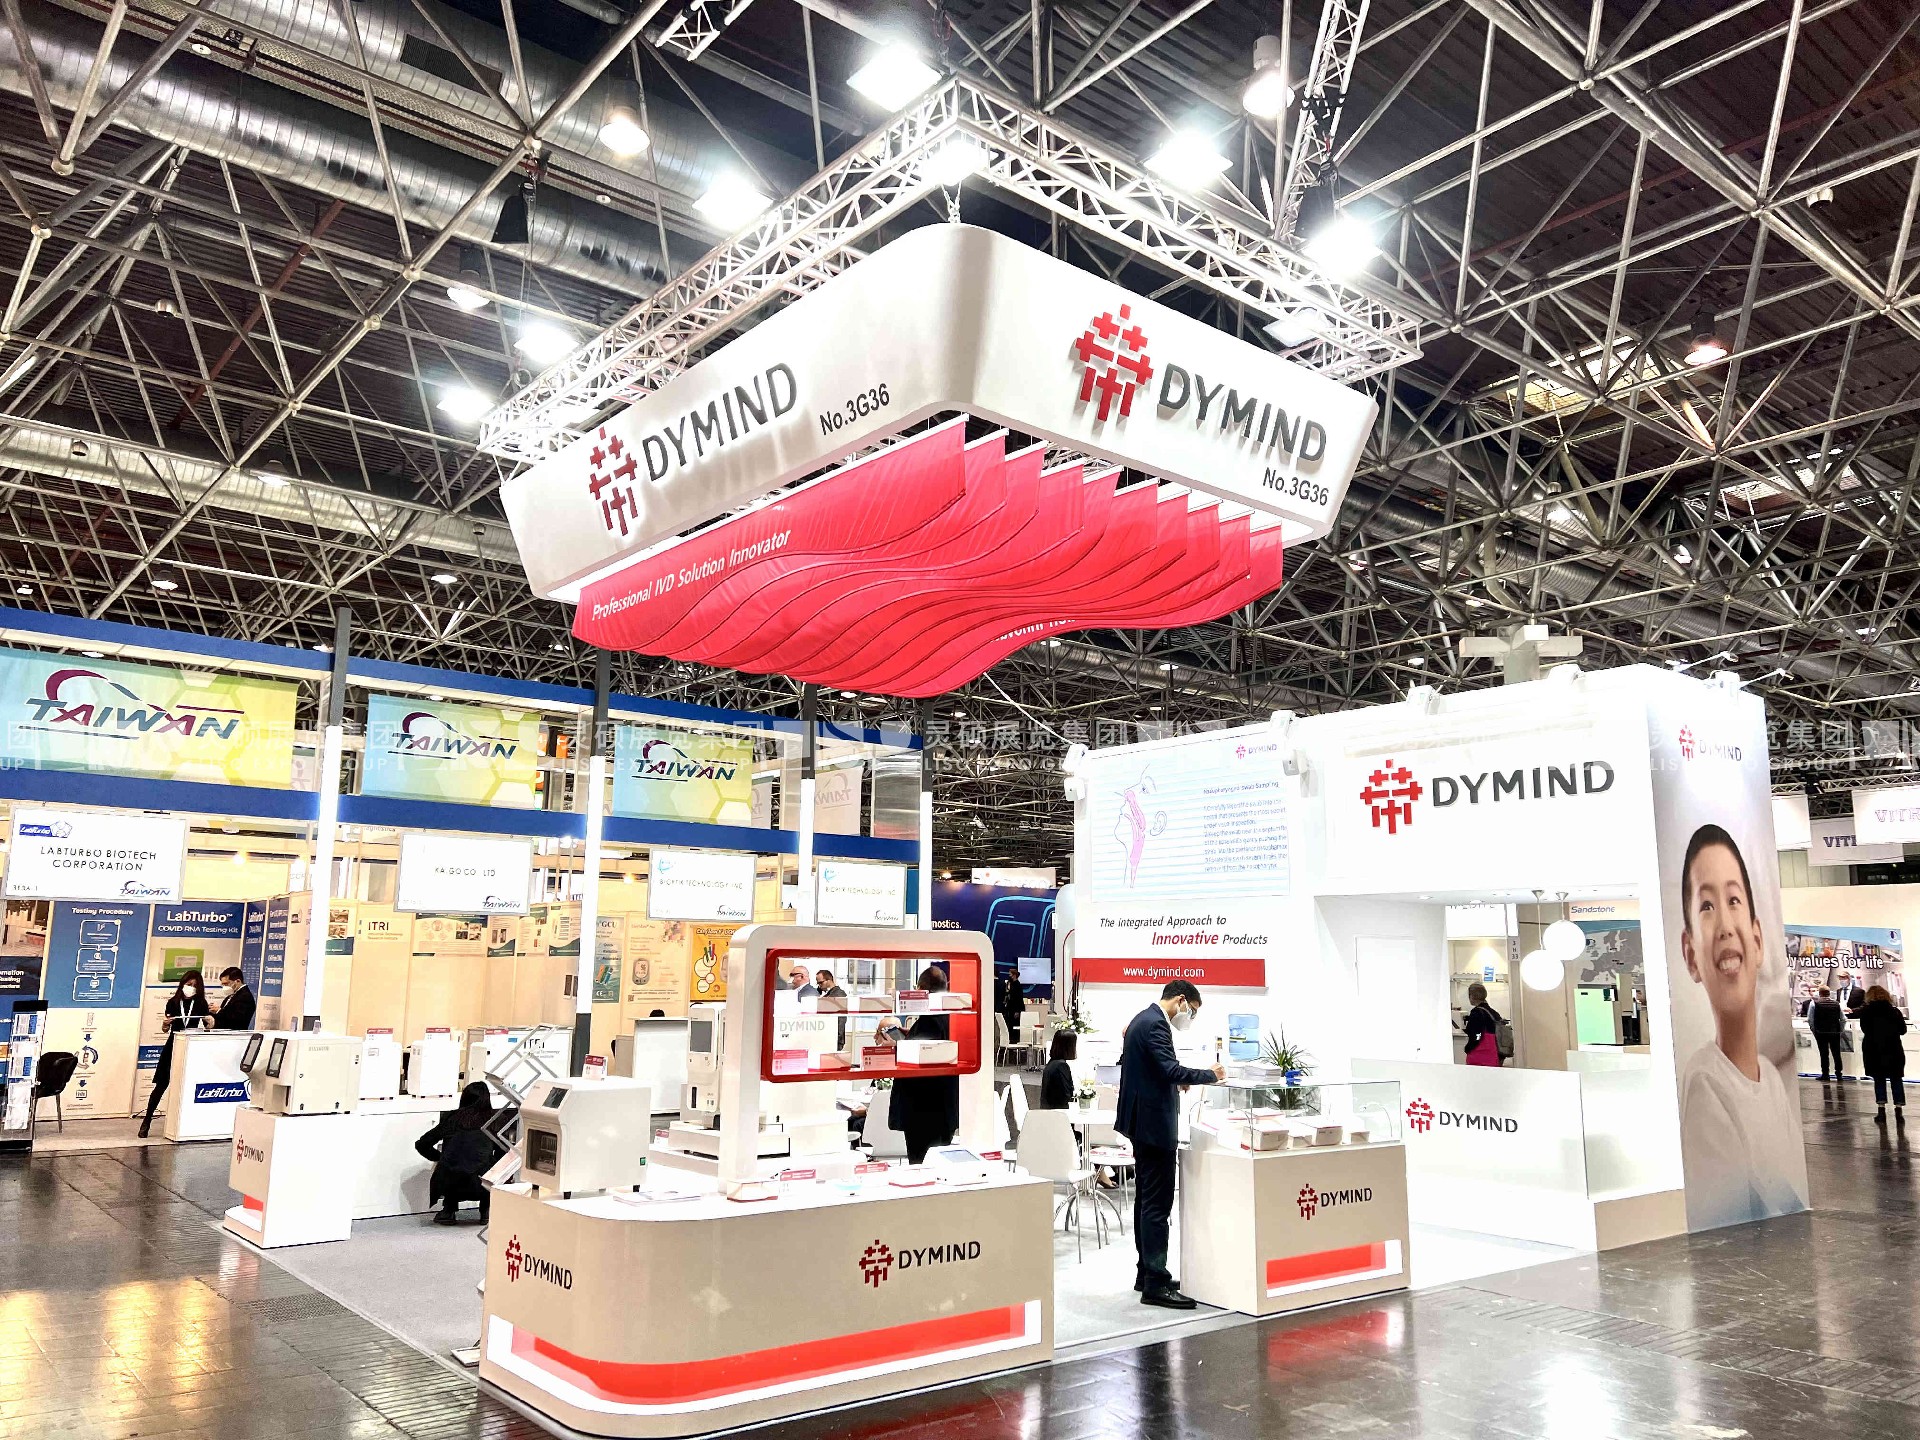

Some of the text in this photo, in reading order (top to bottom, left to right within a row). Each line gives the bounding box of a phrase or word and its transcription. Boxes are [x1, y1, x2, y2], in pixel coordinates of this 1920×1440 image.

[819, 383, 890, 435] No.3G36
[1158, 362, 1327, 462] DYMIND
[643, 362, 797, 482] DYMIND
[1263, 467, 1329, 507] No.3G36
[591, 529, 791, 622] Professional IVD Solution Innovator
[26, 697, 240, 740] TAIWAN
[392, 733, 517, 760] TAIWAN
[1248, 744, 1278, 755] DYMIND
[634, 759, 736, 781] TAIWAN
[1432, 760, 1615, 807] DYMIND
[40, 846, 157, 860] LABTURBO BIOTECH
[52, 859, 143, 871] CORPORATION
[119, 887, 171, 896] TAIWAN
[72, 907, 134, 916] Testing Procedure
[1571, 905, 1616, 914] Sandstone
[368, 921, 389, 931] ITRI
[932, 919, 962, 929] nostics.
[1100, 917, 1115, 928] The
[1166, 914, 1213, 929] Approach
[1216, 915, 1227, 926] to
[202, 926, 227, 934] Testing
[1151, 930, 1268, 946] Innovative Products
[1799, 955, 1839, 968] values
[1843, 953, 1861, 968] for
[1866, 953, 1884, 969] life
[1123, 966, 1205, 979] www.dymind.com
[779, 1020, 825, 1032] DYMIND
[197, 1087, 245, 1099] LabTurbo
[1439, 1111, 1519, 1133] DYMIND
[244, 1145, 265, 1163] DYMIND
[1320, 1187, 1373, 1208] DYMIND
[898, 1241, 981, 1270] DYMIND
[523, 1253, 573, 1290] DYMIND
